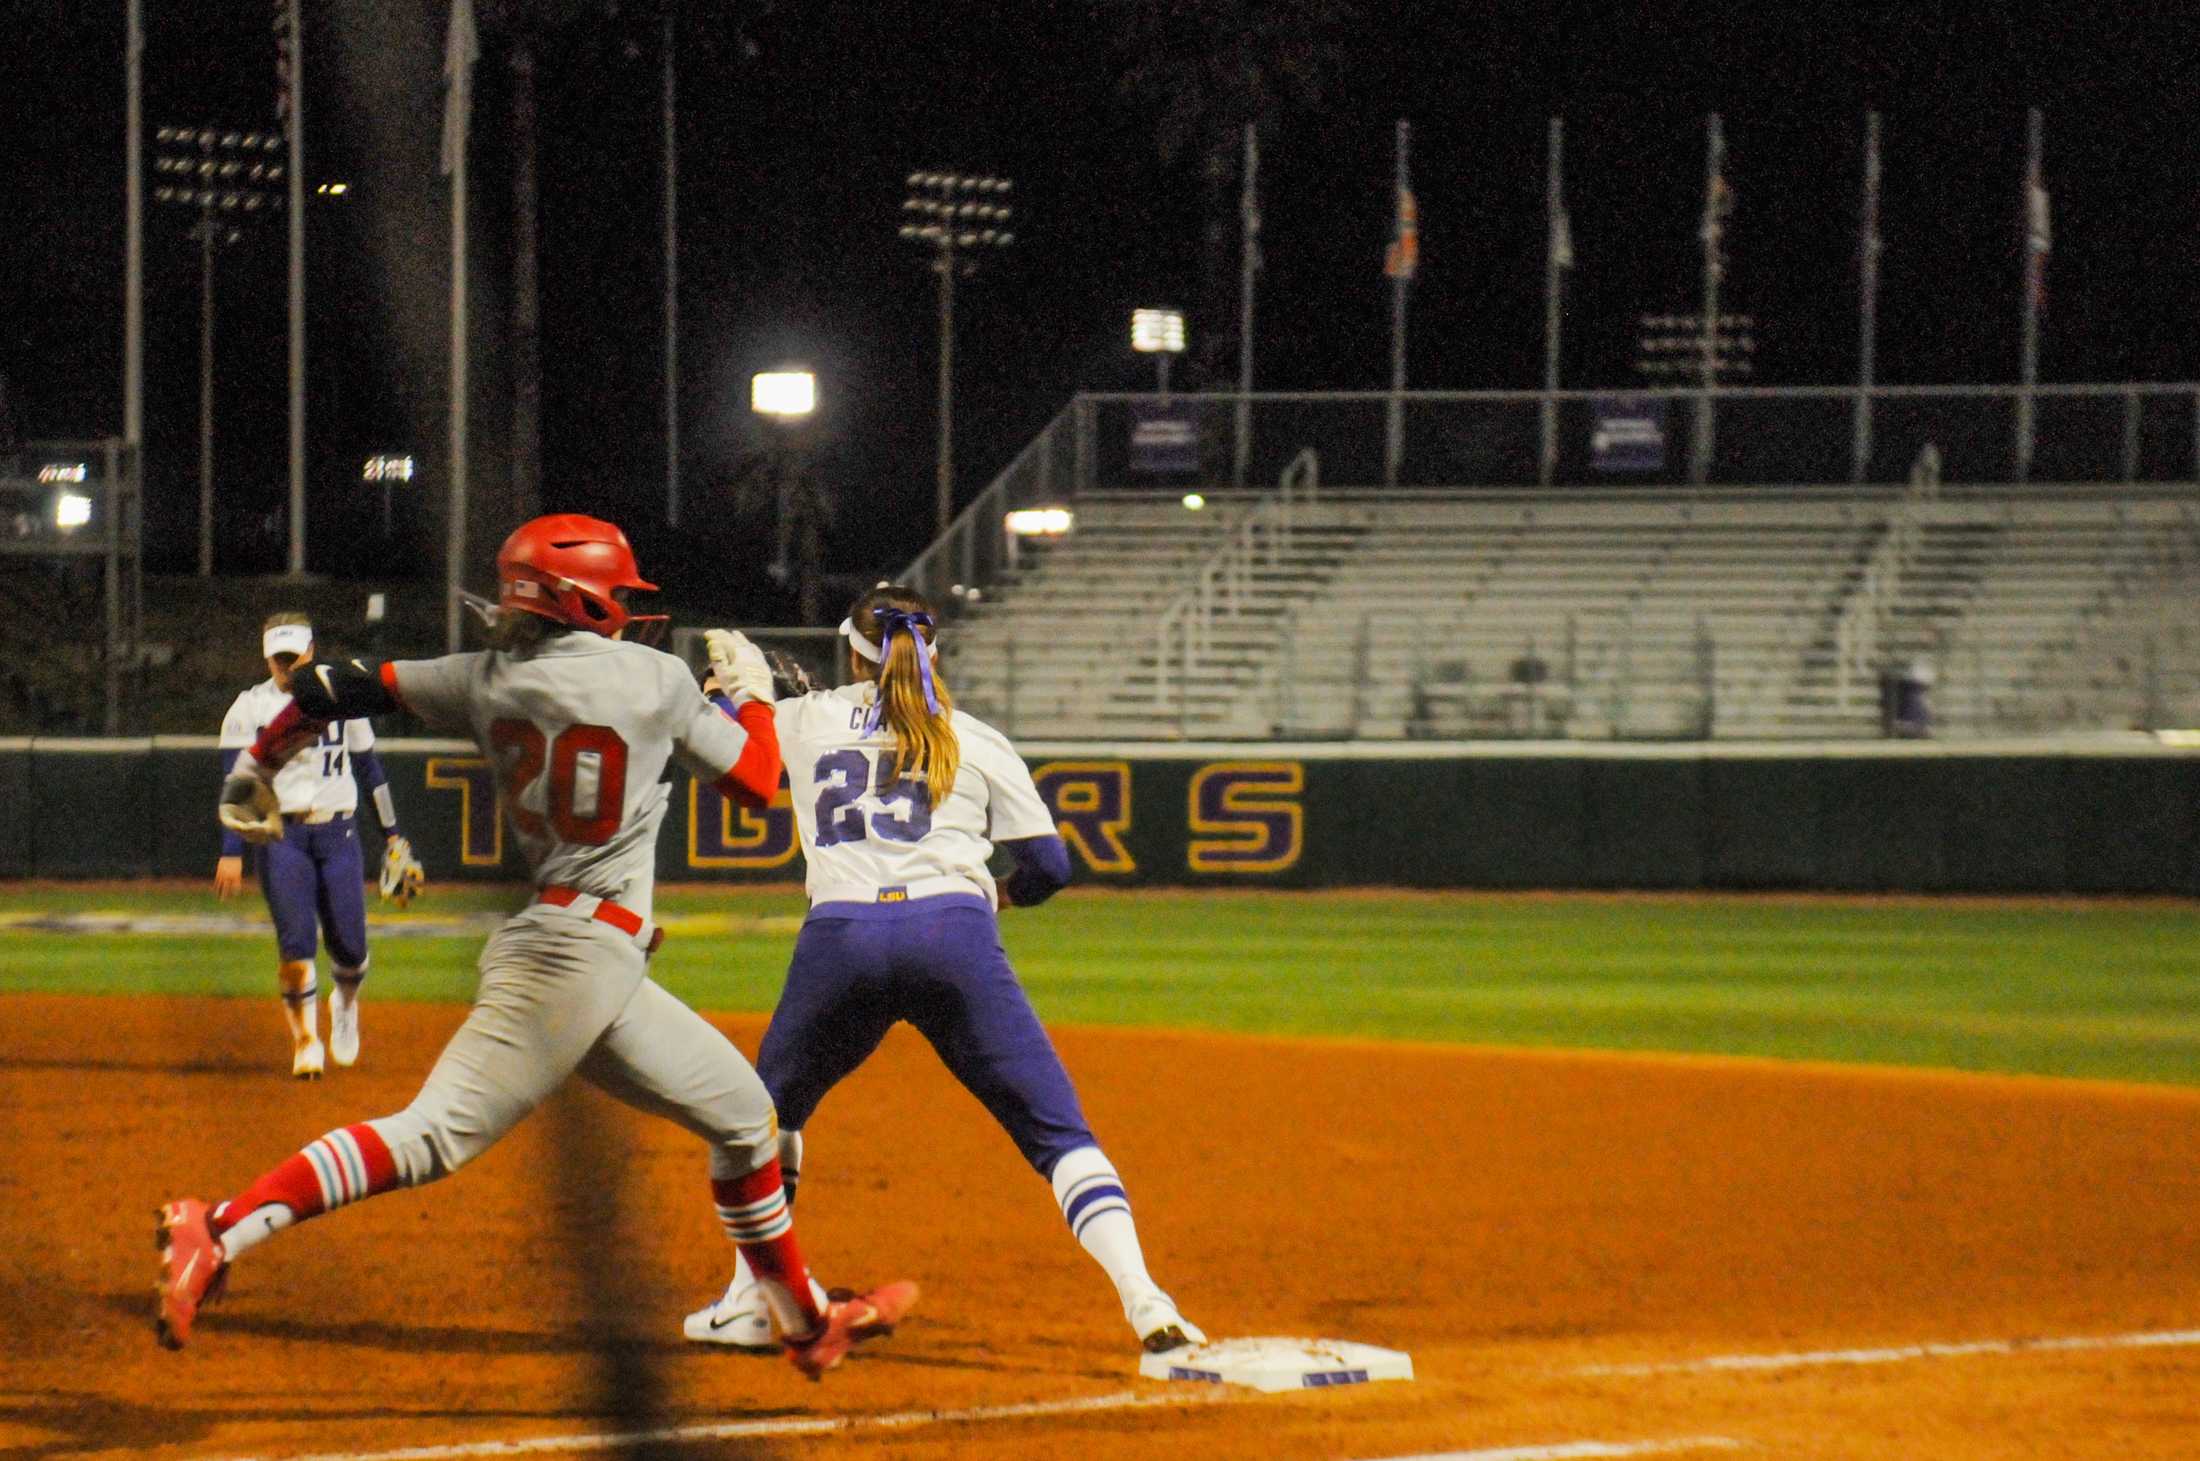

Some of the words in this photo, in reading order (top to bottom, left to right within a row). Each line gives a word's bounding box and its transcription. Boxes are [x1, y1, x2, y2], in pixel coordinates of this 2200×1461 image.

[323, 750, 344, 777] 14
[426, 758, 1304, 872] TGRS
[490, 718, 629, 845] 20
[813, 749, 933, 847] 25
